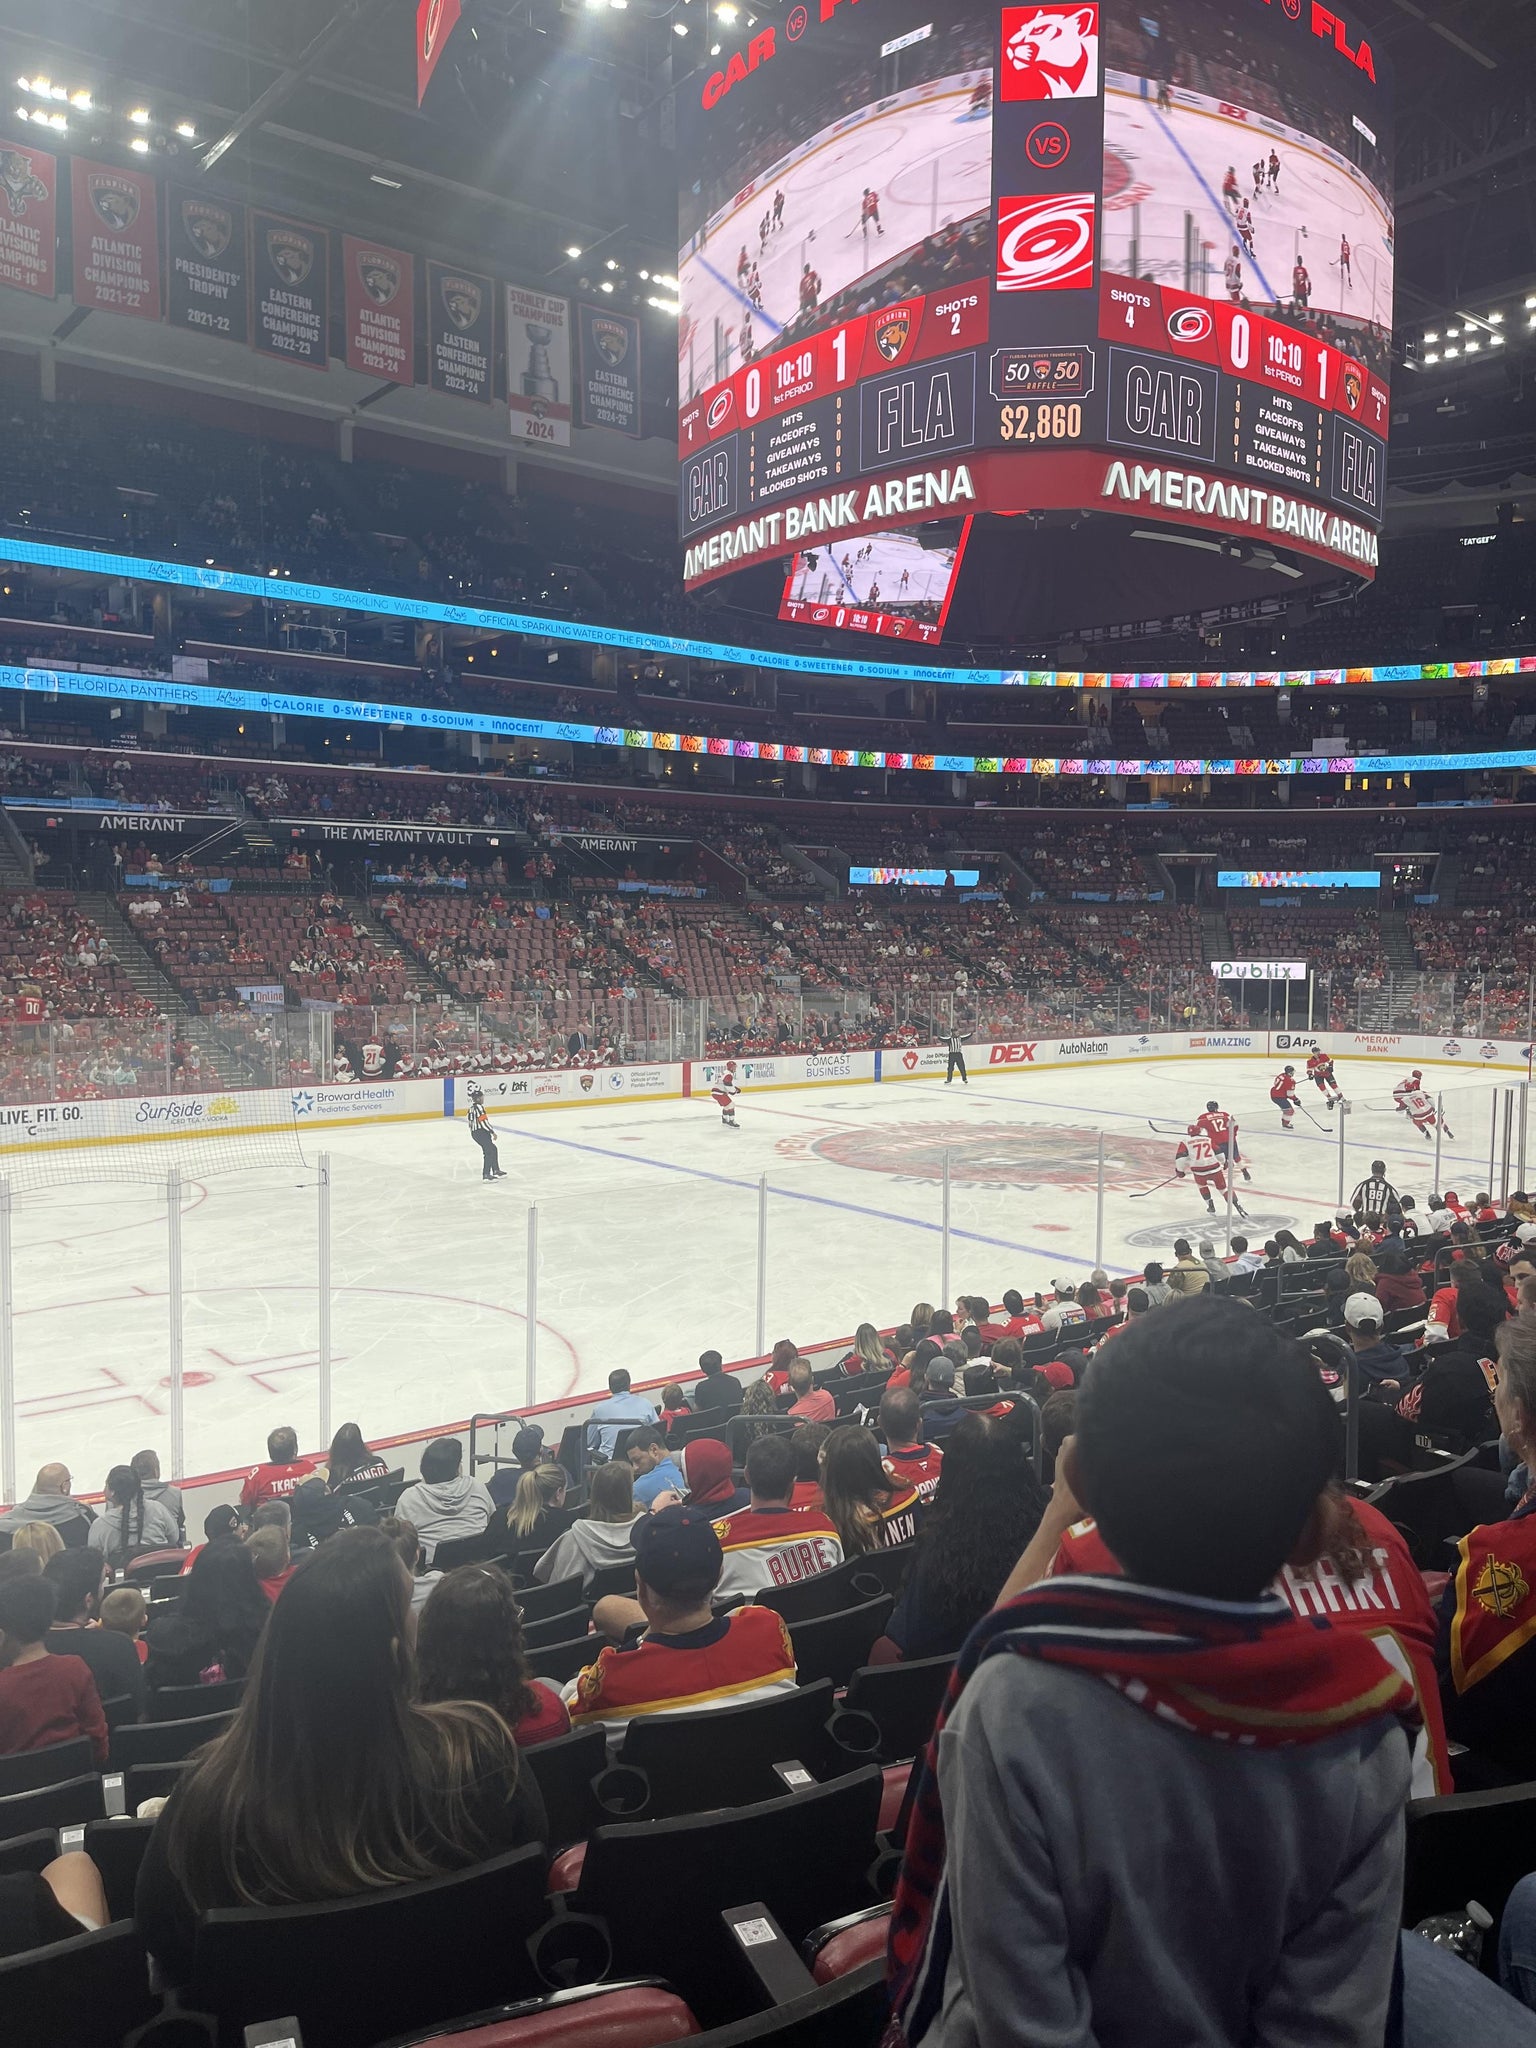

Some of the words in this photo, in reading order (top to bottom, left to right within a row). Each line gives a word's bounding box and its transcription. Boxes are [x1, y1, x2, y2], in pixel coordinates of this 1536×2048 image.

[790, 14, 804, 32] VS
[1312, 0, 1377, 84] FLA
[701, 26, 776, 111] CAR
[1035, 137, 1061, 153] VS
[0, 217, 40, 242] TLANTIC
[91, 236, 142, 259] ATLANTIC
[0, 249, 47, 273] AMPIONS
[92, 253, 141, 275] DIVISION
[175, 257, 241, 286] PRESIDENTS'
[85, 267, 150, 293] CHAMPIONS
[188, 277, 228, 299] TROPHY
[95, 286, 140, 307] 2021-22
[269, 288, 312, 311] EASTERN
[510, 290, 545, 310] STANLEY
[549, 299, 565, 313] CUP
[935, 295, 978, 316] SHOTS
[1110, 289, 1151, 308] SHOTS
[187, 309, 230, 331] 2021-22
[261, 301, 320, 328] CONFERENCE
[360, 309, 401, 331] ATLANTIC
[513, 303, 563, 327] CHAMPIONS
[877, 310, 908, 327] FLORIDA
[951, 313, 961, 336] 2
[1124, 306, 1135, 329] 4
[263, 316, 319, 342] CHAMPIONS
[361, 323, 400, 345] DIVISION
[272, 333, 311, 355] 2022-23
[355, 336, 406, 361] CHAMPIONS
[443, 332, 480, 353] EASTERN
[1230, 314, 1250, 369] 0
[363, 352, 399, 374] 2023-24
[436, 344, 487, 369] CONFERENCE
[832, 329, 847, 382] 1
[1267, 335, 1302, 372] 10:10
[438, 359, 486, 382] CHAMPIONS
[595, 369, 628, 387] EASTERN
[776, 352, 813, 389] 10:10
[1005, 363, 1030, 381] 50
[1054, 361, 1079, 380] 50
[1264, 365, 1276, 378] 1st
[1275, 369, 1303, 387] PERIOD
[1317, 349, 1328, 400] 1
[445, 374, 478, 394] 2023-24
[588, 380, 634, 402] CONFERENCE
[746, 369, 760, 418] 0
[774, 393, 785, 404] 1st
[785, 381, 814, 401] PERIOD
[1026, 381, 1057, 390] RAFFLE
[590, 394, 633, 414] CHAMPIONS
[1125, 365, 1202, 446] CAR
[1272, 396, 1293, 411] HITS
[1371, 386, 1387, 406] SHOTS
[597, 408, 628, 426] 2024-25
[682, 409, 699, 427] SHOTS
[782, 412, 803, 427] HITS
[878, 372, 954, 454] FLA
[1259, 408, 1304, 432] FACEOFFS
[1376, 402, 1381, 421] 2
[526, 419, 555, 440] 2024
[1000, 403, 1082, 443] $2,860
[770, 422, 816, 447] FACEOFFS
[1255, 424, 1306, 449] GIVEAWAYS
[767, 437, 820, 464] GIVEAWAYS
[836, 429, 841, 441] 0
[1253, 439, 1307, 466] TAKEAWAYS
[765, 452, 822, 479] TAKEAWAYS
[836, 445, 841, 457] 0
[1246, 454, 1285, 475] BLOCKED
[1285, 464, 1311, 484] SHOTS
[1341, 431, 1377, 508] FLA
[689, 451, 728, 523] CAR
[759, 476, 797, 497] BLOCKED
[797, 466, 828, 483] SHOTS
[683, 511, 782, 580] AMERANT
[785, 489, 859, 541] BANK
[862, 464, 976, 521] ARENA
[1105, 461, 1268, 526] AMERANT
[1271, 504, 1328, 546] BANK
[1329, 518, 1380, 568] ARENA
[194, 571, 258, 593] NATURALLY
[264, 581, 320, 600] ESSENCED
[332, 592, 389, 610] SPARKLING
[394, 601, 428, 615] WATER
[479, 613, 520, 628] OFFICIAL
[521, 620, 571, 636] SPARKLING
[573, 627, 604, 640] WATER
[604, 632, 617, 642] OF
[618, 634, 634, 645] THE
[635, 637, 671, 649] FLORIDA
[671, 642, 713, 656] PANTHERS
[750, 653, 790, 667] 0-CALORIE
[794, 659, 853, 673] 0-SWEETENER
[858, 665, 900, 676] 0-SODIUM
[913, 669, 955, 680] INNOCENT!
[15, 672, 34, 686] OF
[38, 675, 65, 689] THE
[69, 678, 127, 695] FLORIDA
[130, 683, 198, 701] PANTHERS
[261, 697, 325, 713] 0-CALORIE
[333, 704, 413, 721] 0-SWEETENER
[421, 713, 474, 727] 0-SODIUM
[492, 721, 544, 734] INNOCENT!
[1405, 757, 1459, 767] NATURALLY
[1463, 754, 1517, 766] ESSENCED
[100, 815, 186, 833] AMERANT
[322, 826, 349, 840] THE
[353, 827, 423, 843] AMERANT
[427, 830, 473, 845] VAULT
[580, 838, 637, 852] AMERANT
[1220, 963, 1291, 978] Publix
[25, 1001, 41, 1015] 00
[1058, 1041, 1108, 1055] AutoNation
[1207, 1037, 1251, 1047] AMAZING
[1355, 1035, 1402, 1045] AMERANT
[1366, 1045, 1389, 1053] BANK
[365, 1051, 377, 1065] 21
[806, 1054, 851, 1067] COMCAST
[989, 1043, 1038, 1064] DEX
[754, 1062, 774, 1072] TROPICAL
[754, 1070, 775, 1078] FINANCIAL
[806, 1065, 851, 1077] BUSINESS
[317, 1090, 361, 1102] Broward
[362, 1089, 395, 1099] Health
[0, 1108, 33, 1124] LIVE.
[36, 1107, 58, 1123] FIT.
[62, 1106, 84, 1121] GO.
[135, 1101, 203, 1123] Surfside
[317, 1104, 350, 1113] Pediatric
[352, 1103, 382, 1111] Services
[1211, 1119, 1226, 1132] 12
[1192, 1142, 1212, 1160] 72
[1368, 1189, 1383, 1201] 88
[271, 1477, 300, 1493] TKAC
[767, 1538, 832, 1587] BURE
